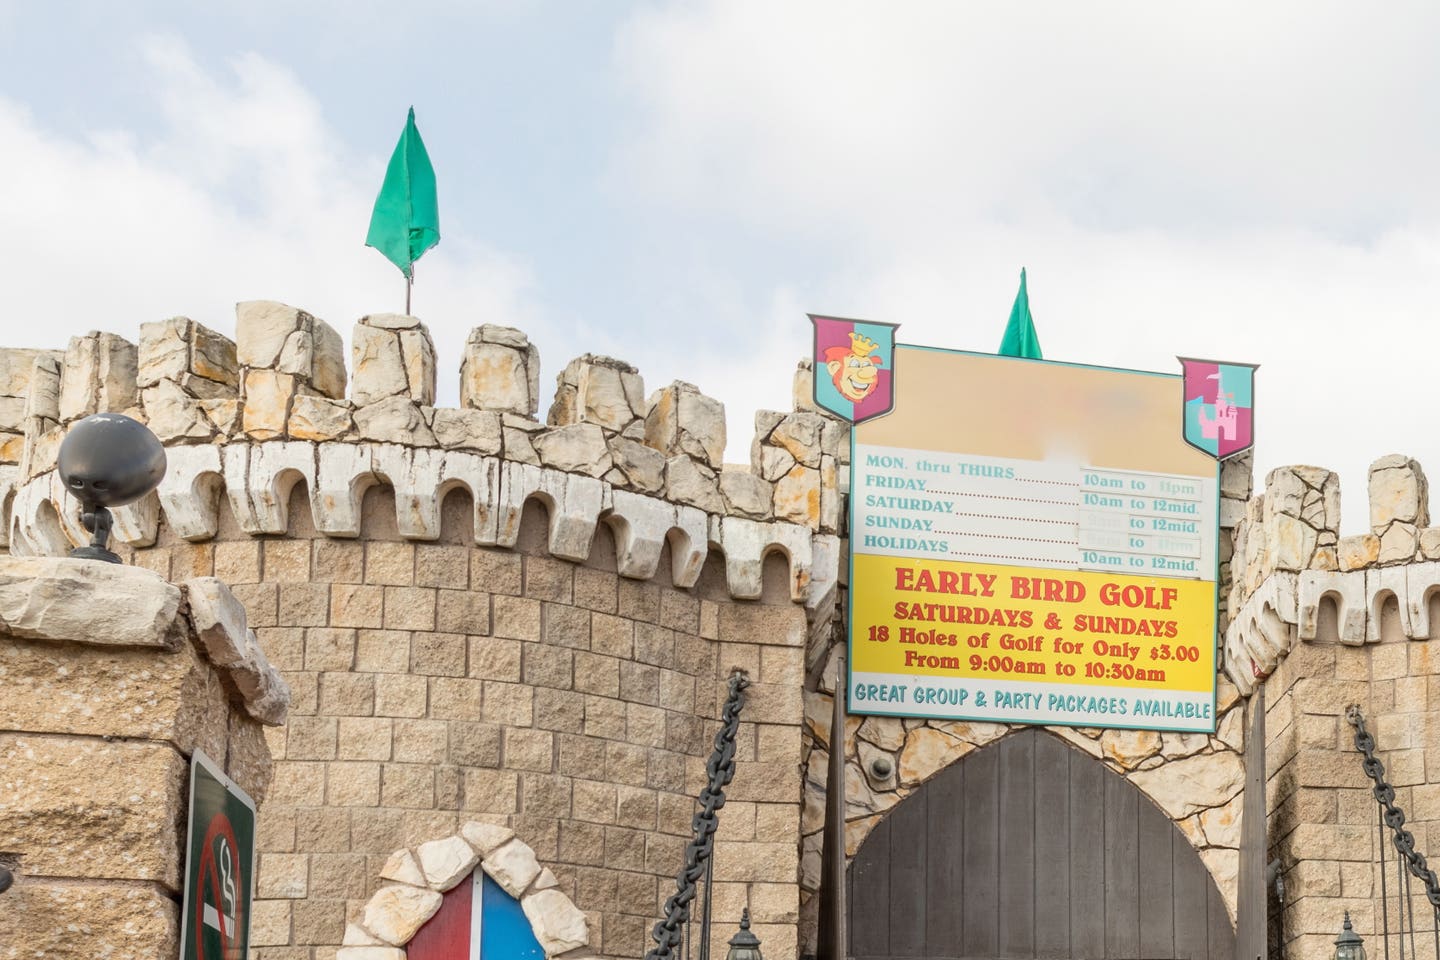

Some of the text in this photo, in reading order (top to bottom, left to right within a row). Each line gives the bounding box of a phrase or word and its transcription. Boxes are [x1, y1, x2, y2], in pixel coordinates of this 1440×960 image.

[866, 454, 1195, 495] MON. thru THURS 10am to 11pm
[865, 474, 1200, 515] FRIDAY 10am to 12mid.
[865, 495, 954, 513] SATURDAY
[1129, 518, 1145, 529] to
[1152, 519, 1199, 533] 12mid.
[865, 515, 933, 531] SUNDAY
[1129, 537, 1145, 548] to
[864, 535, 1199, 572] HOLIDAYS 10am to 12mid.
[895, 567, 1178, 610] EARLY BIRD GOLF
[894, 601, 1178, 638] SATURDAYS & SUNDAYS
[868, 625, 1200, 663] 18 Holes of Golf for Only $3.00
[904, 650, 1166, 682] From 9:00am to 10:30am
[855, 683, 1211, 720] GREAT GROUP & PARTY PACKAGES AVAILABLE
